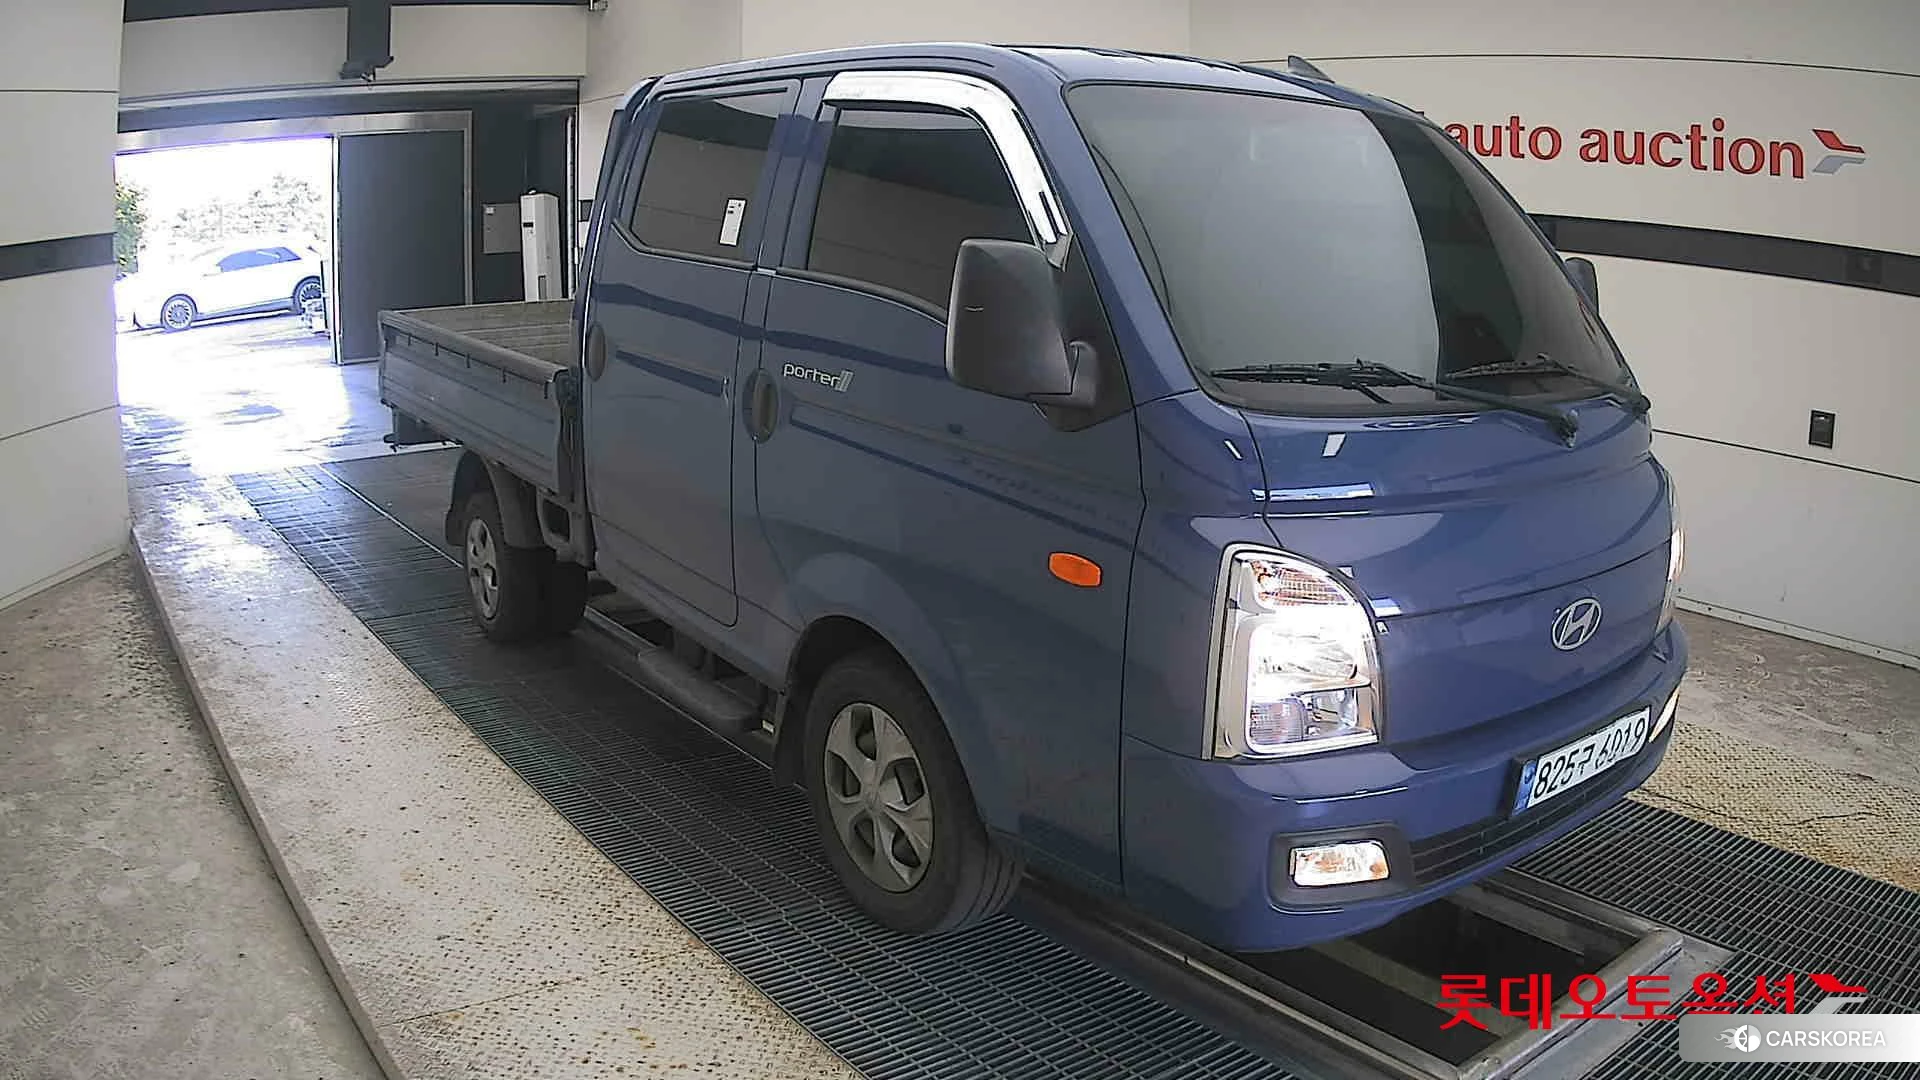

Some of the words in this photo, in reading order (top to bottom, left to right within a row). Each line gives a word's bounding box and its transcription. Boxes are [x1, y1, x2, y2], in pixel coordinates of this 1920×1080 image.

[1444, 116, 1562, 160] auto
[1579, 118, 1804, 178] auction
[1534, 743, 1595, 799] 825구
[1595, 717, 1646, 769] 6019
